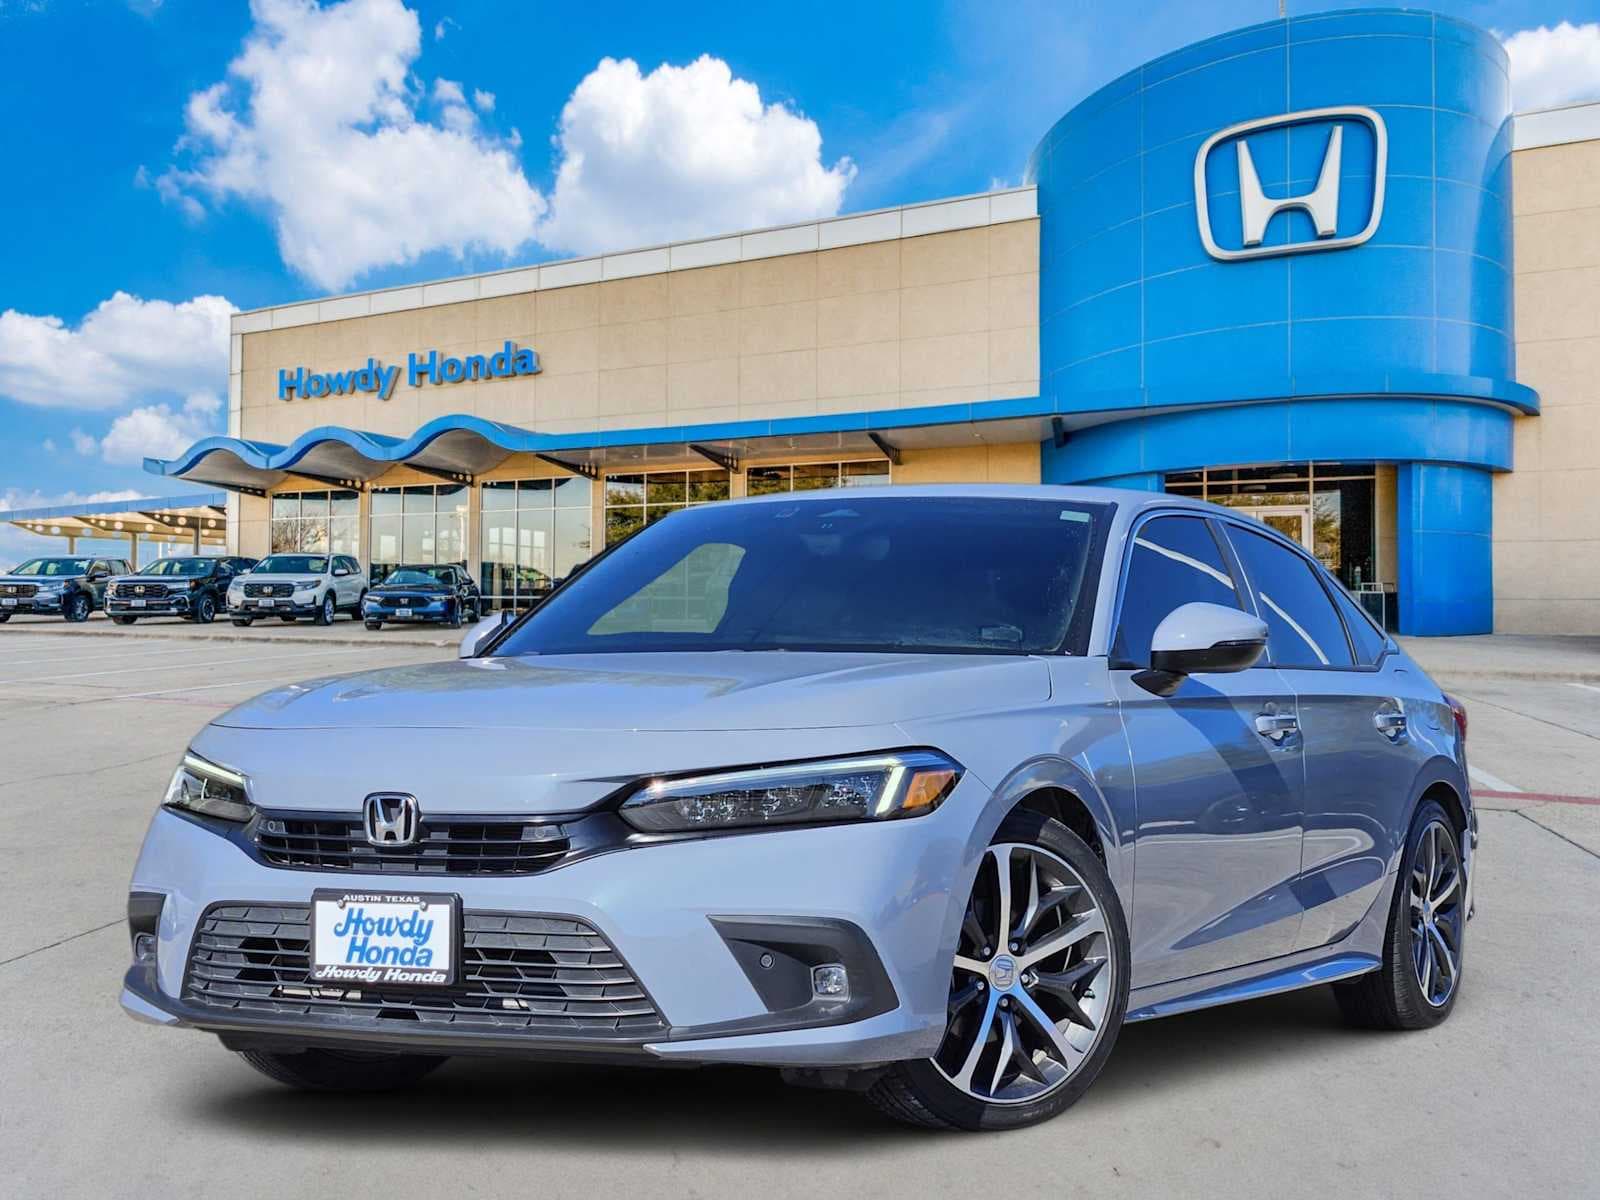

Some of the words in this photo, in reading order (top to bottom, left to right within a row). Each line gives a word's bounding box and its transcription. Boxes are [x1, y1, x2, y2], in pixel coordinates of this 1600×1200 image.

[278, 358, 401, 400] Howdy
[407, 341, 542, 387] Honda
[343, 894, 381, 902] AUSTIN
[385, 895, 420, 903] TEXAS
[334, 908, 434, 945] Howdy
[346, 937, 433, 967] Honda
[315, 965, 382, 982] Howdy
[383, 968, 447, 983] Honda
